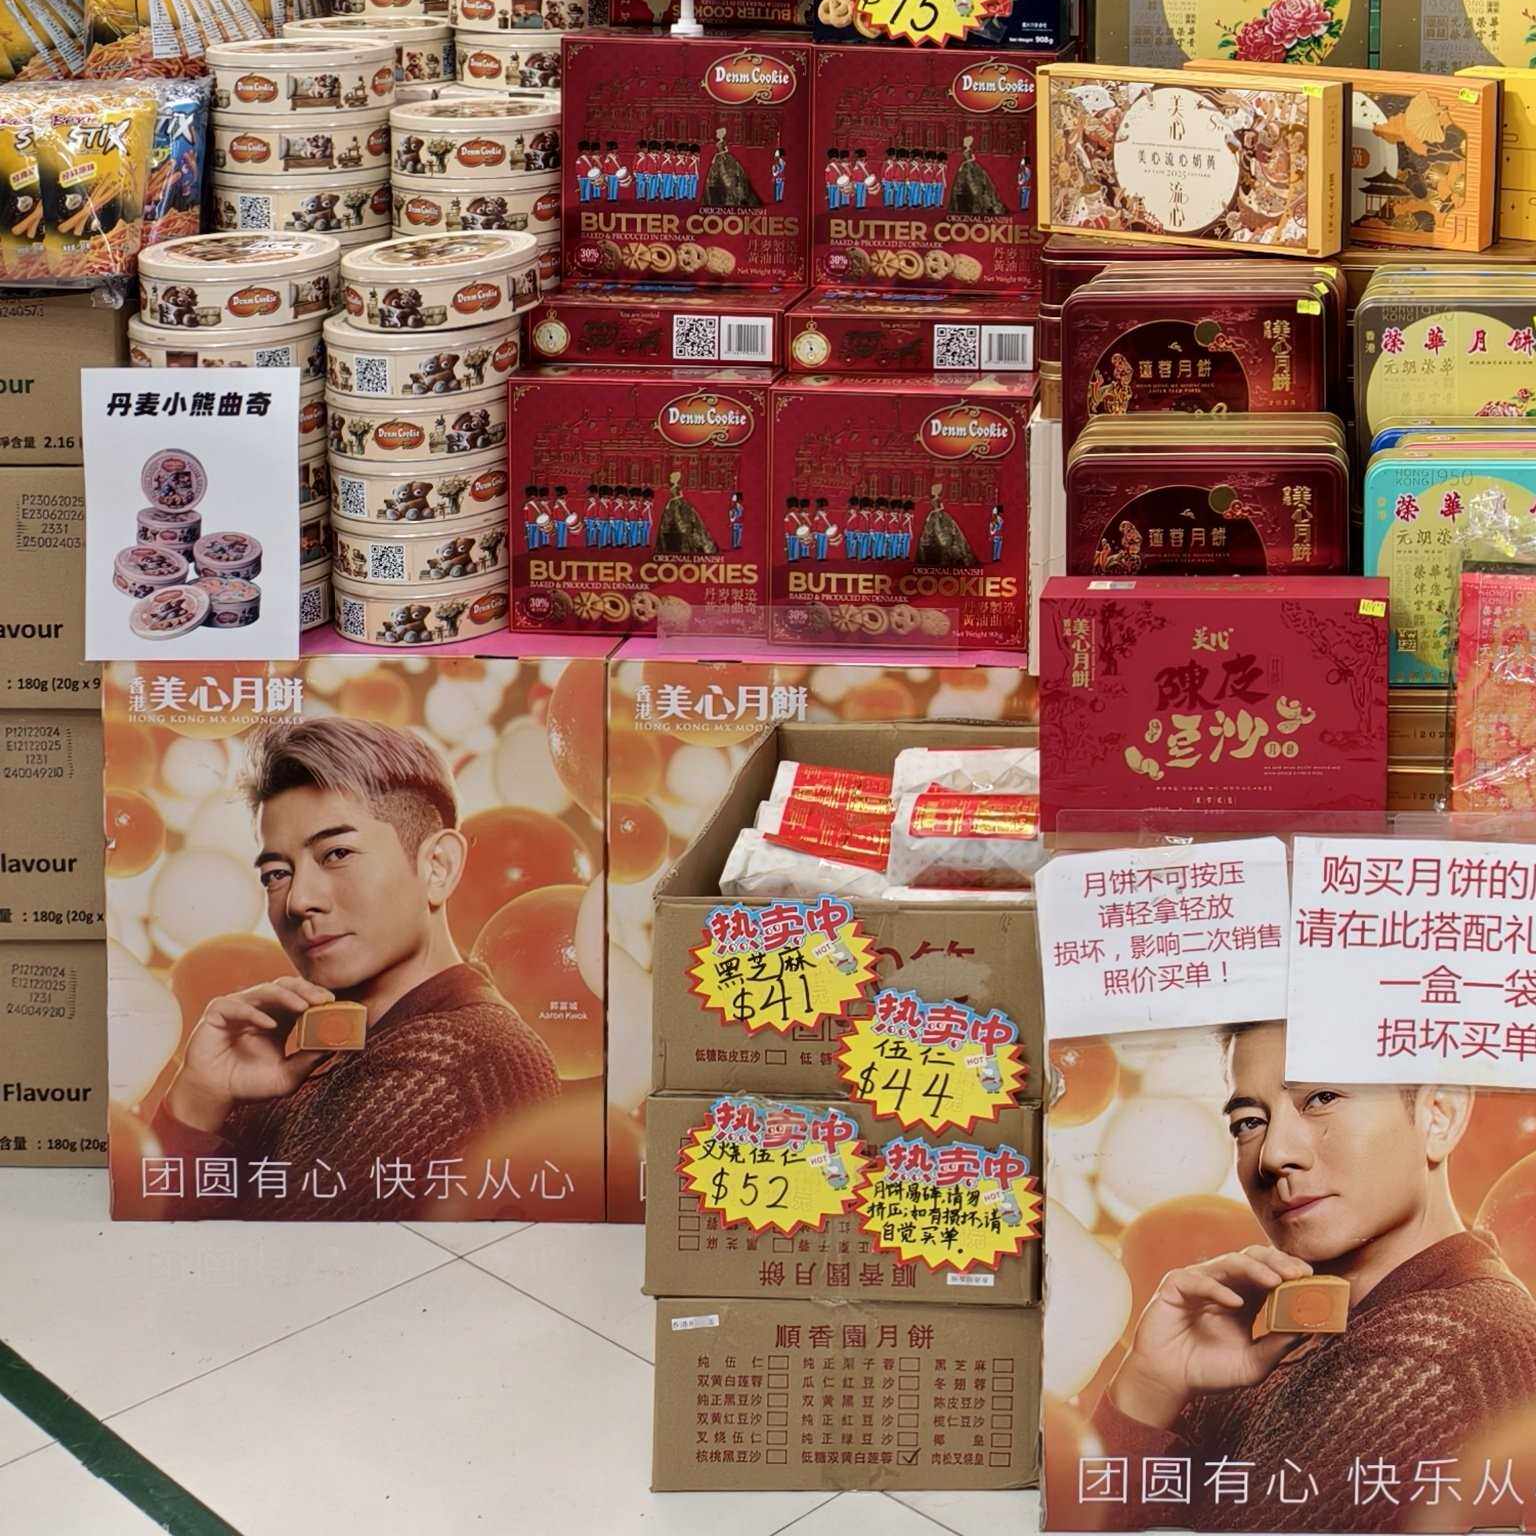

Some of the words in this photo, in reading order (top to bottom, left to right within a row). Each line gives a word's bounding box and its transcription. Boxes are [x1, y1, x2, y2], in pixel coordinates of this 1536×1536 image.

[581, 212, 683, 236] BUTTER
[687, 213, 800, 237] COOKIES
[829, 218, 931, 243] BUTTER
[1382, 326, 1536, 359] 榮華月餅
[1138, 358, 1212, 379] 蓮蓉月餅
[106, 392, 273, 419] 丹麦小熊曲奇
[529, 559, 632, 582] BUTTER
[640, 563, 759, 585] COOKIES
[788, 571, 894, 596] BUTTER
[898, 575, 1018, 600] COOKIES
[1071, 618, 1092, 689] 美心月餅
[150, 676, 304, 713] 美心月餅
[1155, 653, 1272, 712] 陳皮
[655, 684, 808, 721] 美心月餅
[1082, 859, 1246, 899] 月饼不可按压
[711, 897, 851, 955] 热卖中
[1098, 895, 1234, 930] 请轻拿轻放
[714, 946, 817, 990] 黑芝麻
[732, 974, 813, 1023] $41
[872, 991, 1018, 1055] 热卖中
[695, 1048, 762, 1065] 低糖陈皮豆沙
[874, 1037, 955, 1066] 伍仁
[3, 1083, 92, 1103] Flavour
[858, 1062, 954, 1118] $44
[714, 1101, 854, 1155] 热卖中
[700, 1138, 807, 1166] 叉烧伍仁
[885, 1143, 1027, 1190] 热卖中
[140, 1156, 346, 1201] 团圆有心
[369, 1156, 575, 1201] 快乐从心
[711, 1166, 790, 1210] $52
[758, 1261, 917, 1289] 順香園月餅
[774, 1323, 935, 1350] 順香園月餅
[1075, 1453, 1320, 1507] 团圆有心
